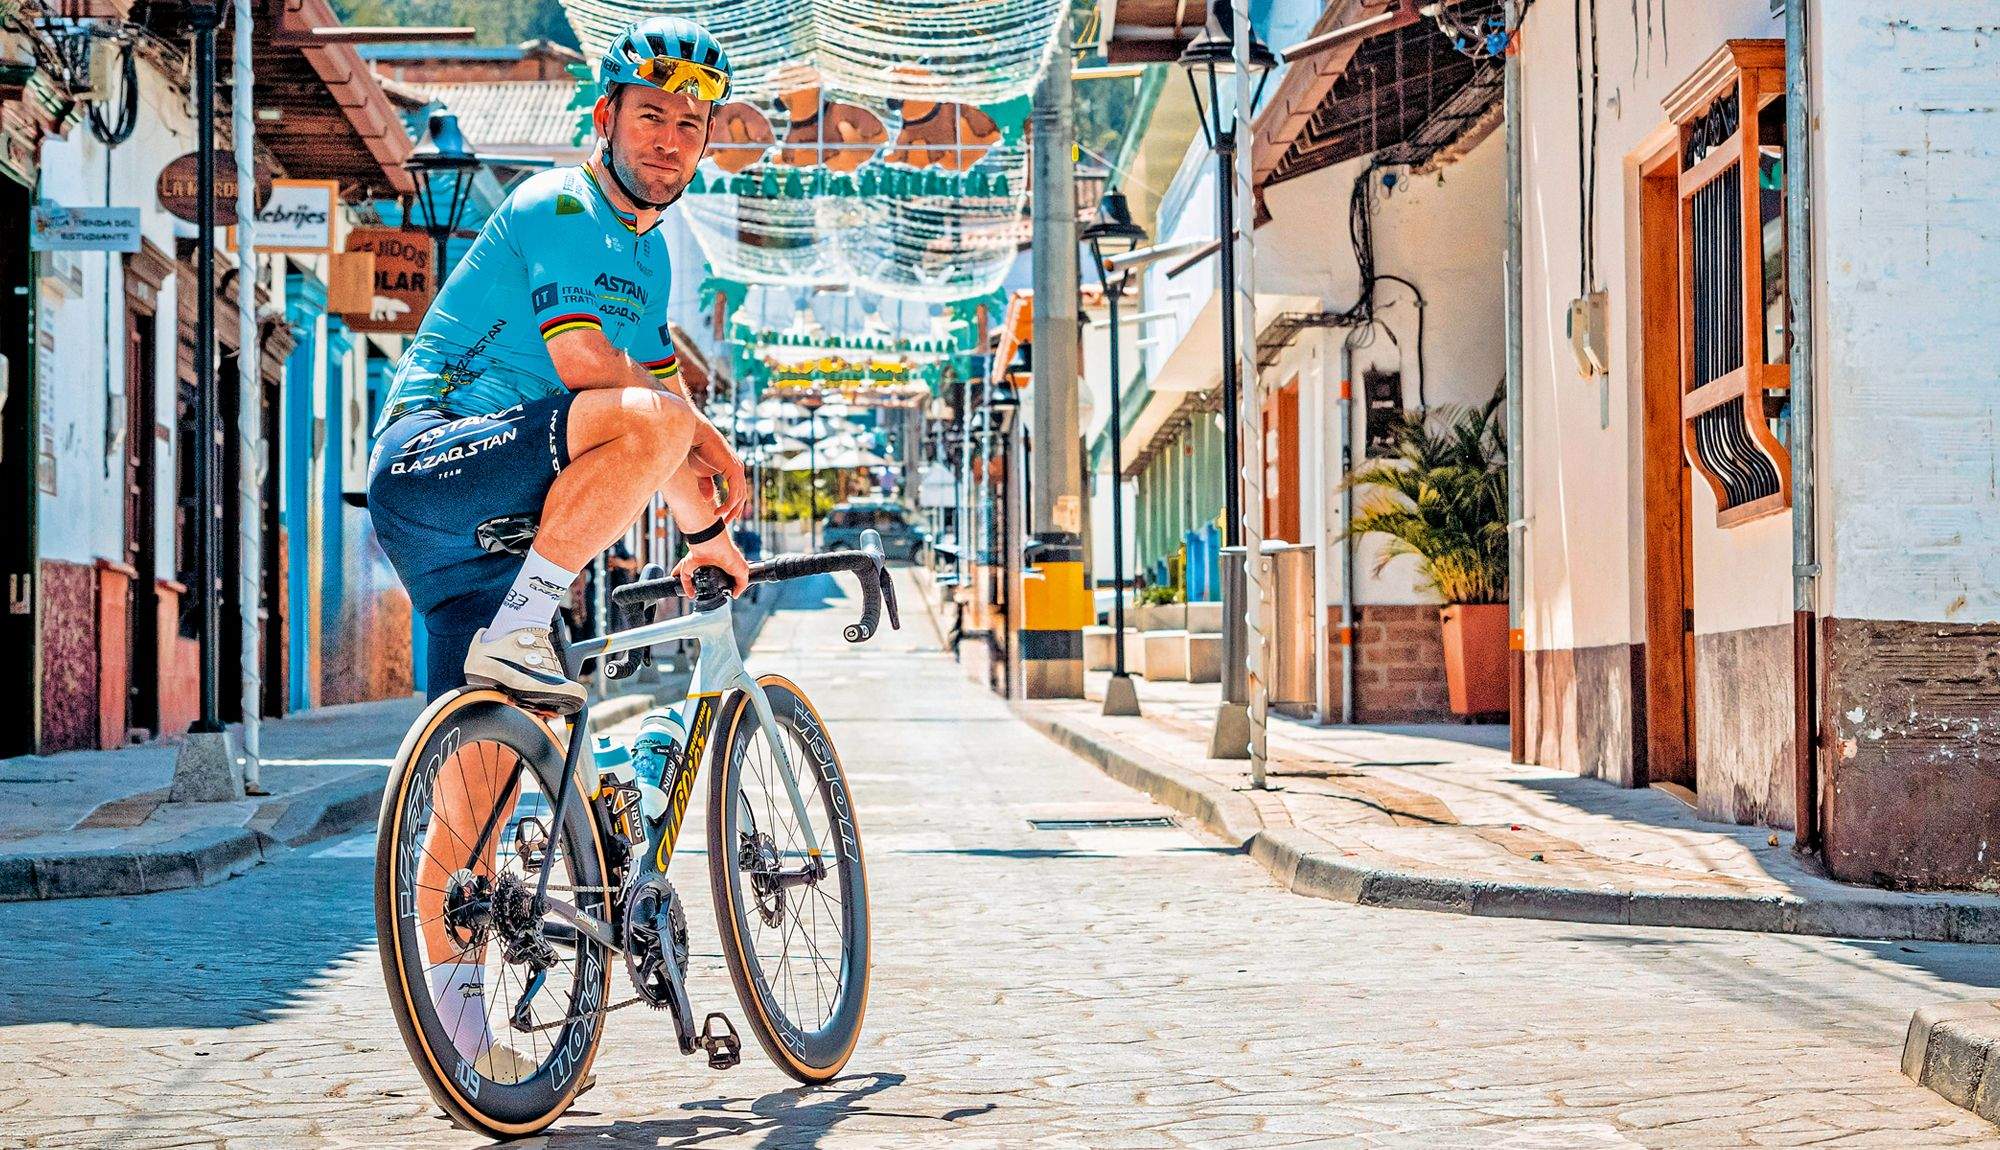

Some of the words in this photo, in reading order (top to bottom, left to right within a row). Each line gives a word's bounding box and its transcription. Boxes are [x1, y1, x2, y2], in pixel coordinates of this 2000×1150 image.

[535, 290, 549, 307] IT
[390, 427, 517, 475] QAZAQSTAN
[438, 468, 462, 480] TEAM
